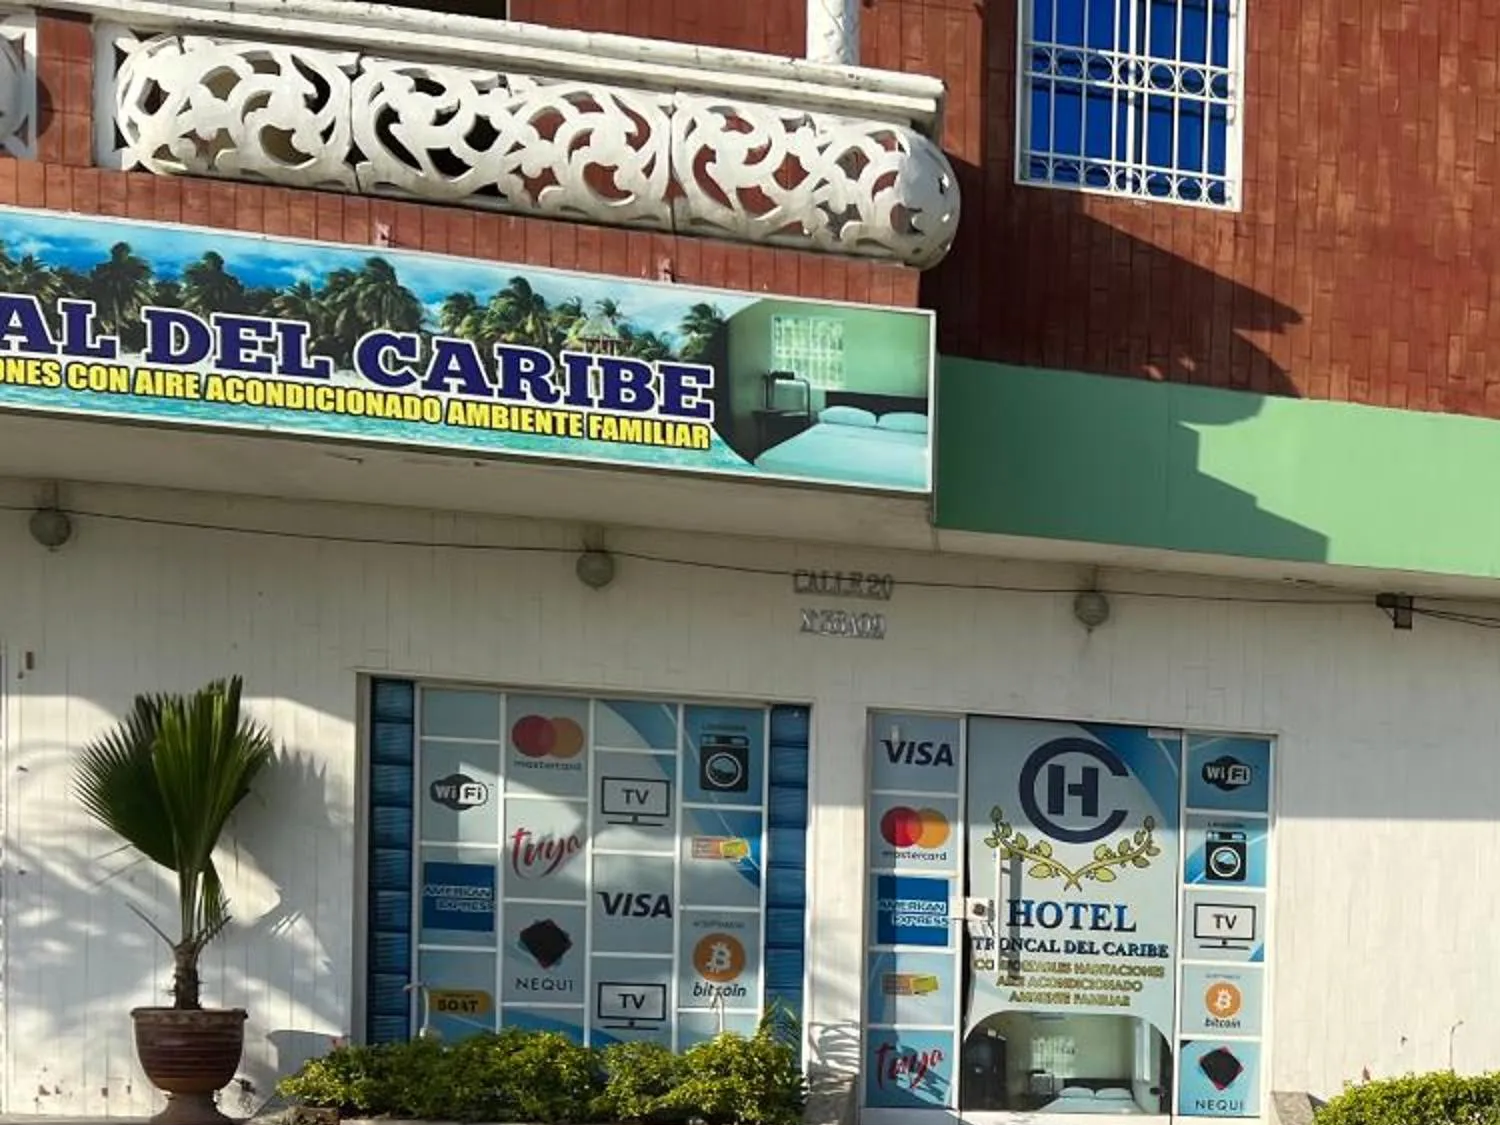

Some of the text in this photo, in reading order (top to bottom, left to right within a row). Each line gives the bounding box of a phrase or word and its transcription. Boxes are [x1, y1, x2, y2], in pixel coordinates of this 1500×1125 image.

[141, 306, 333, 379] DEL
[354, 330, 714, 421] CARIBE
[66, 362, 130, 393] CON
[132, 368, 201, 398] AIRE
[205, 374, 443, 424] ACONDICIONADO
[445, 398, 585, 438] AMBIENTE
[586, 413, 712, 450] FAMILIAR
[879, 739, 954, 767] VISA
[622, 788, 649, 805] TV
[422, 885, 492, 899] AMERICAN
[435, 899, 495, 913] EXPRESS
[597, 891, 673, 919] VISA
[878, 899, 947, 915] AMERICAN
[891, 913, 950, 927] EXPRESS
[1005, 899, 1138, 933] HOTEL
[1212, 914, 1238, 930] TV
[971, 935, 1170, 959] TRONCAL DEL CARIBE
[514, 977, 574, 992] NEQUI
[618, 993, 646, 1010] TV
[1194, 1099, 1244, 1112] NEQUI
